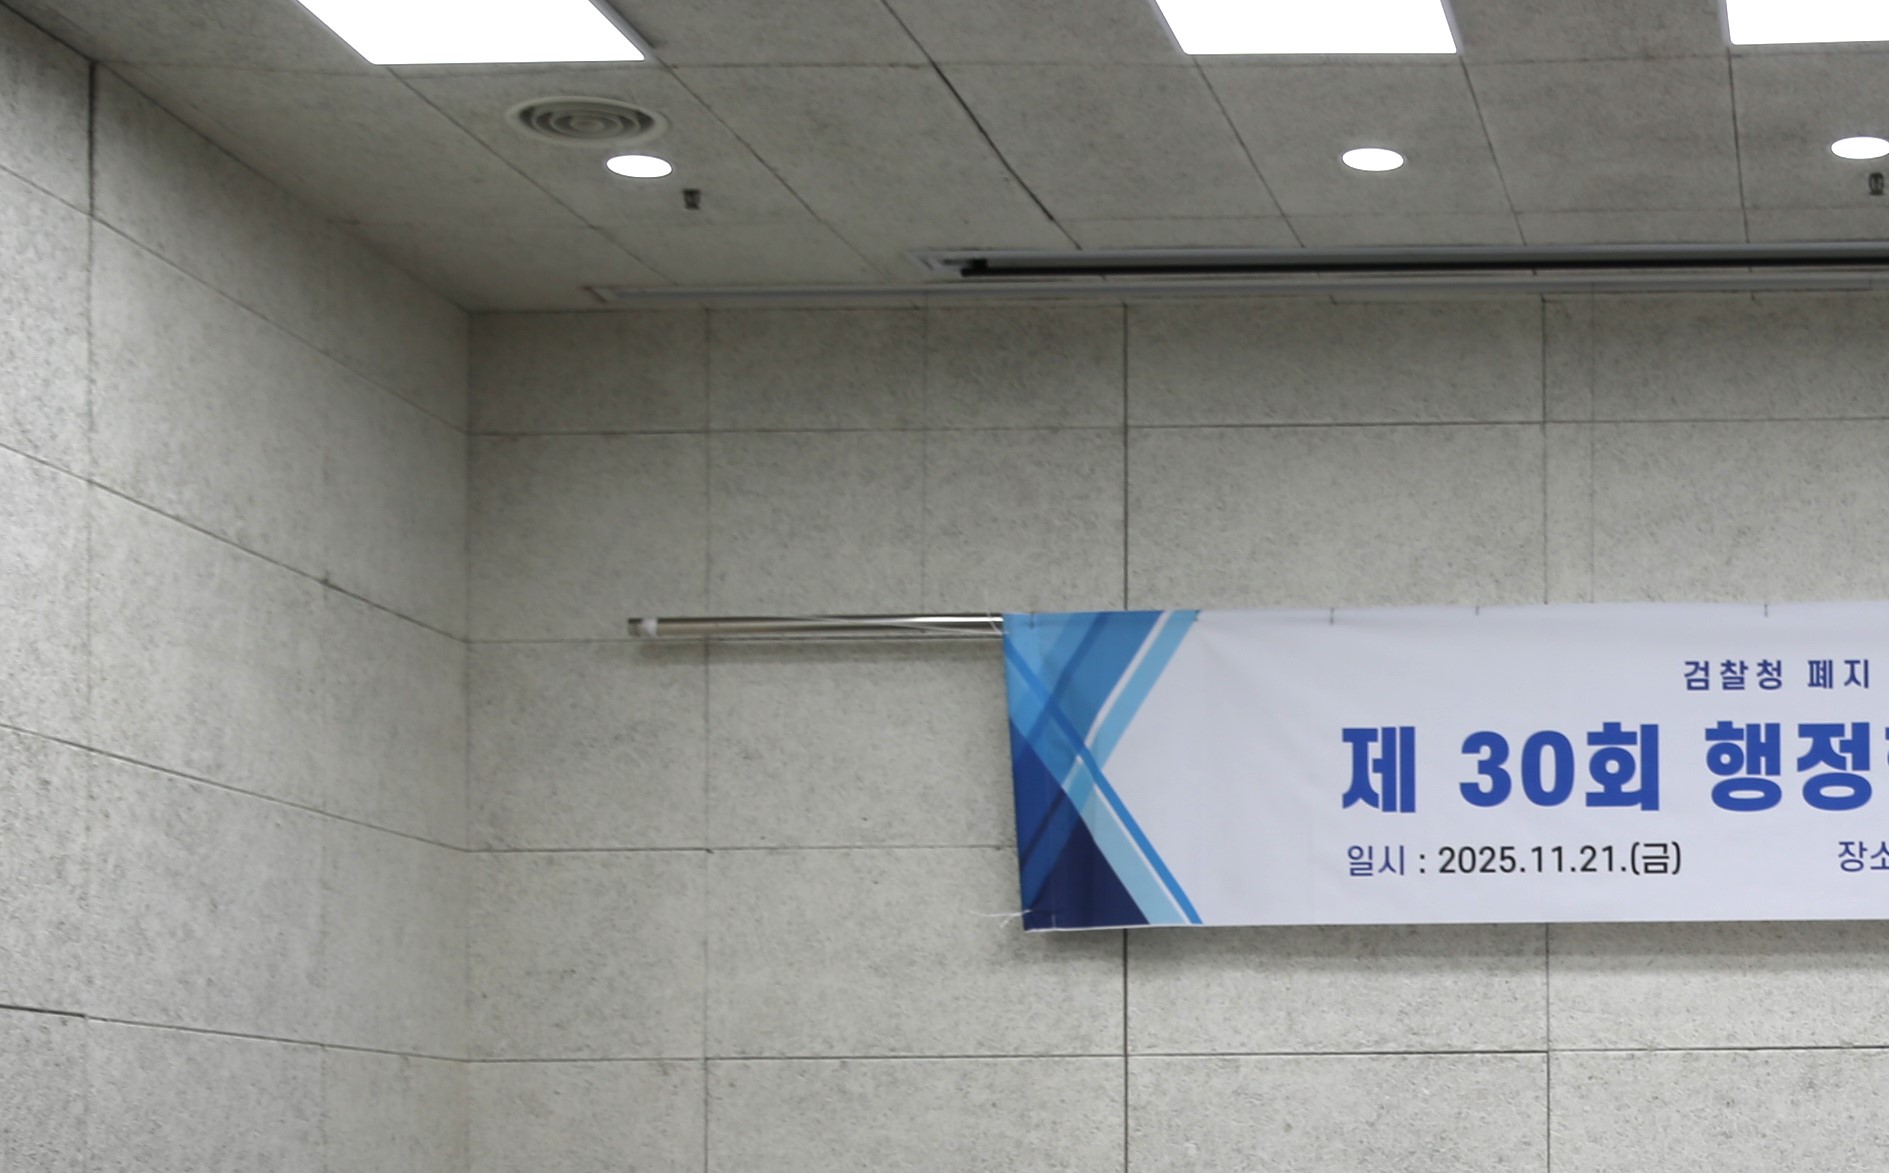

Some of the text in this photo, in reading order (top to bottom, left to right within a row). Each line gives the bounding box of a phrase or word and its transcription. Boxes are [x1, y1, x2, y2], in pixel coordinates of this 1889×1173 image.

[1683, 659, 1784, 692] 검찰청
[1807, 658, 1871, 691] 폐지
[1341, 725, 1417, 815] 제
[1459, 721, 1661, 813] 30회
[1347, 845, 1406, 878] 일시
[1438, 841, 1682, 877] 2025.11.21.(금)
